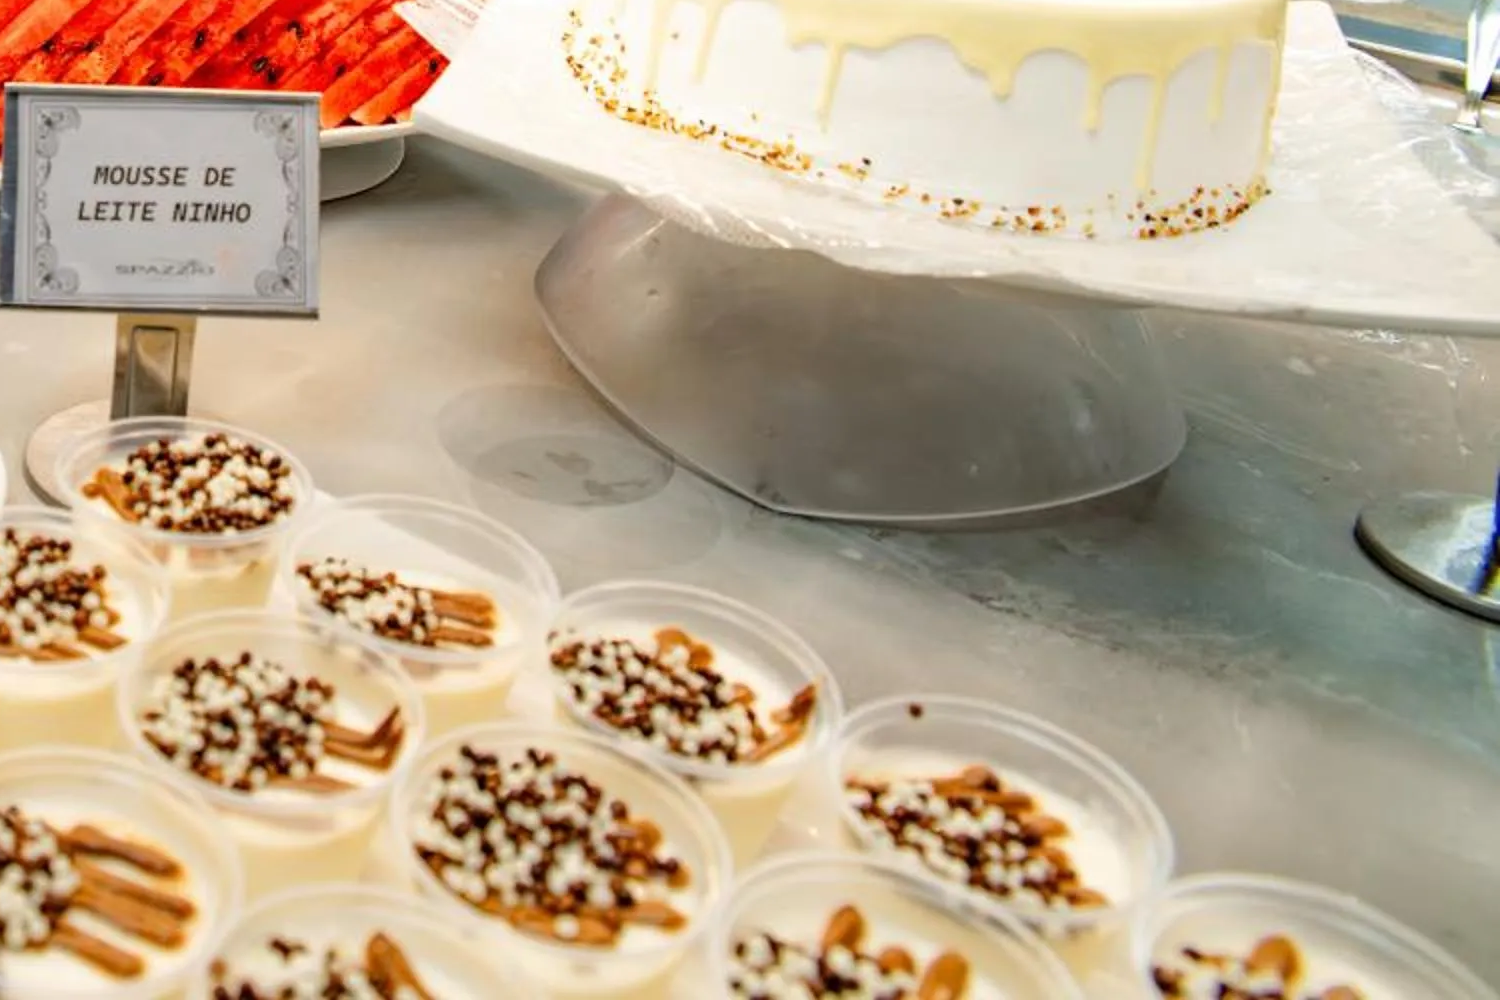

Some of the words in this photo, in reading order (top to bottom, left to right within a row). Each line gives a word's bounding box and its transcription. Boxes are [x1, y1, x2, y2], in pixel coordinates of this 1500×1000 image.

[93, 165, 188, 187] MOUSSE
[204, 166, 236, 188] DE
[77, 201, 157, 222] LEITE
[172, 202, 252, 225] NINHO
